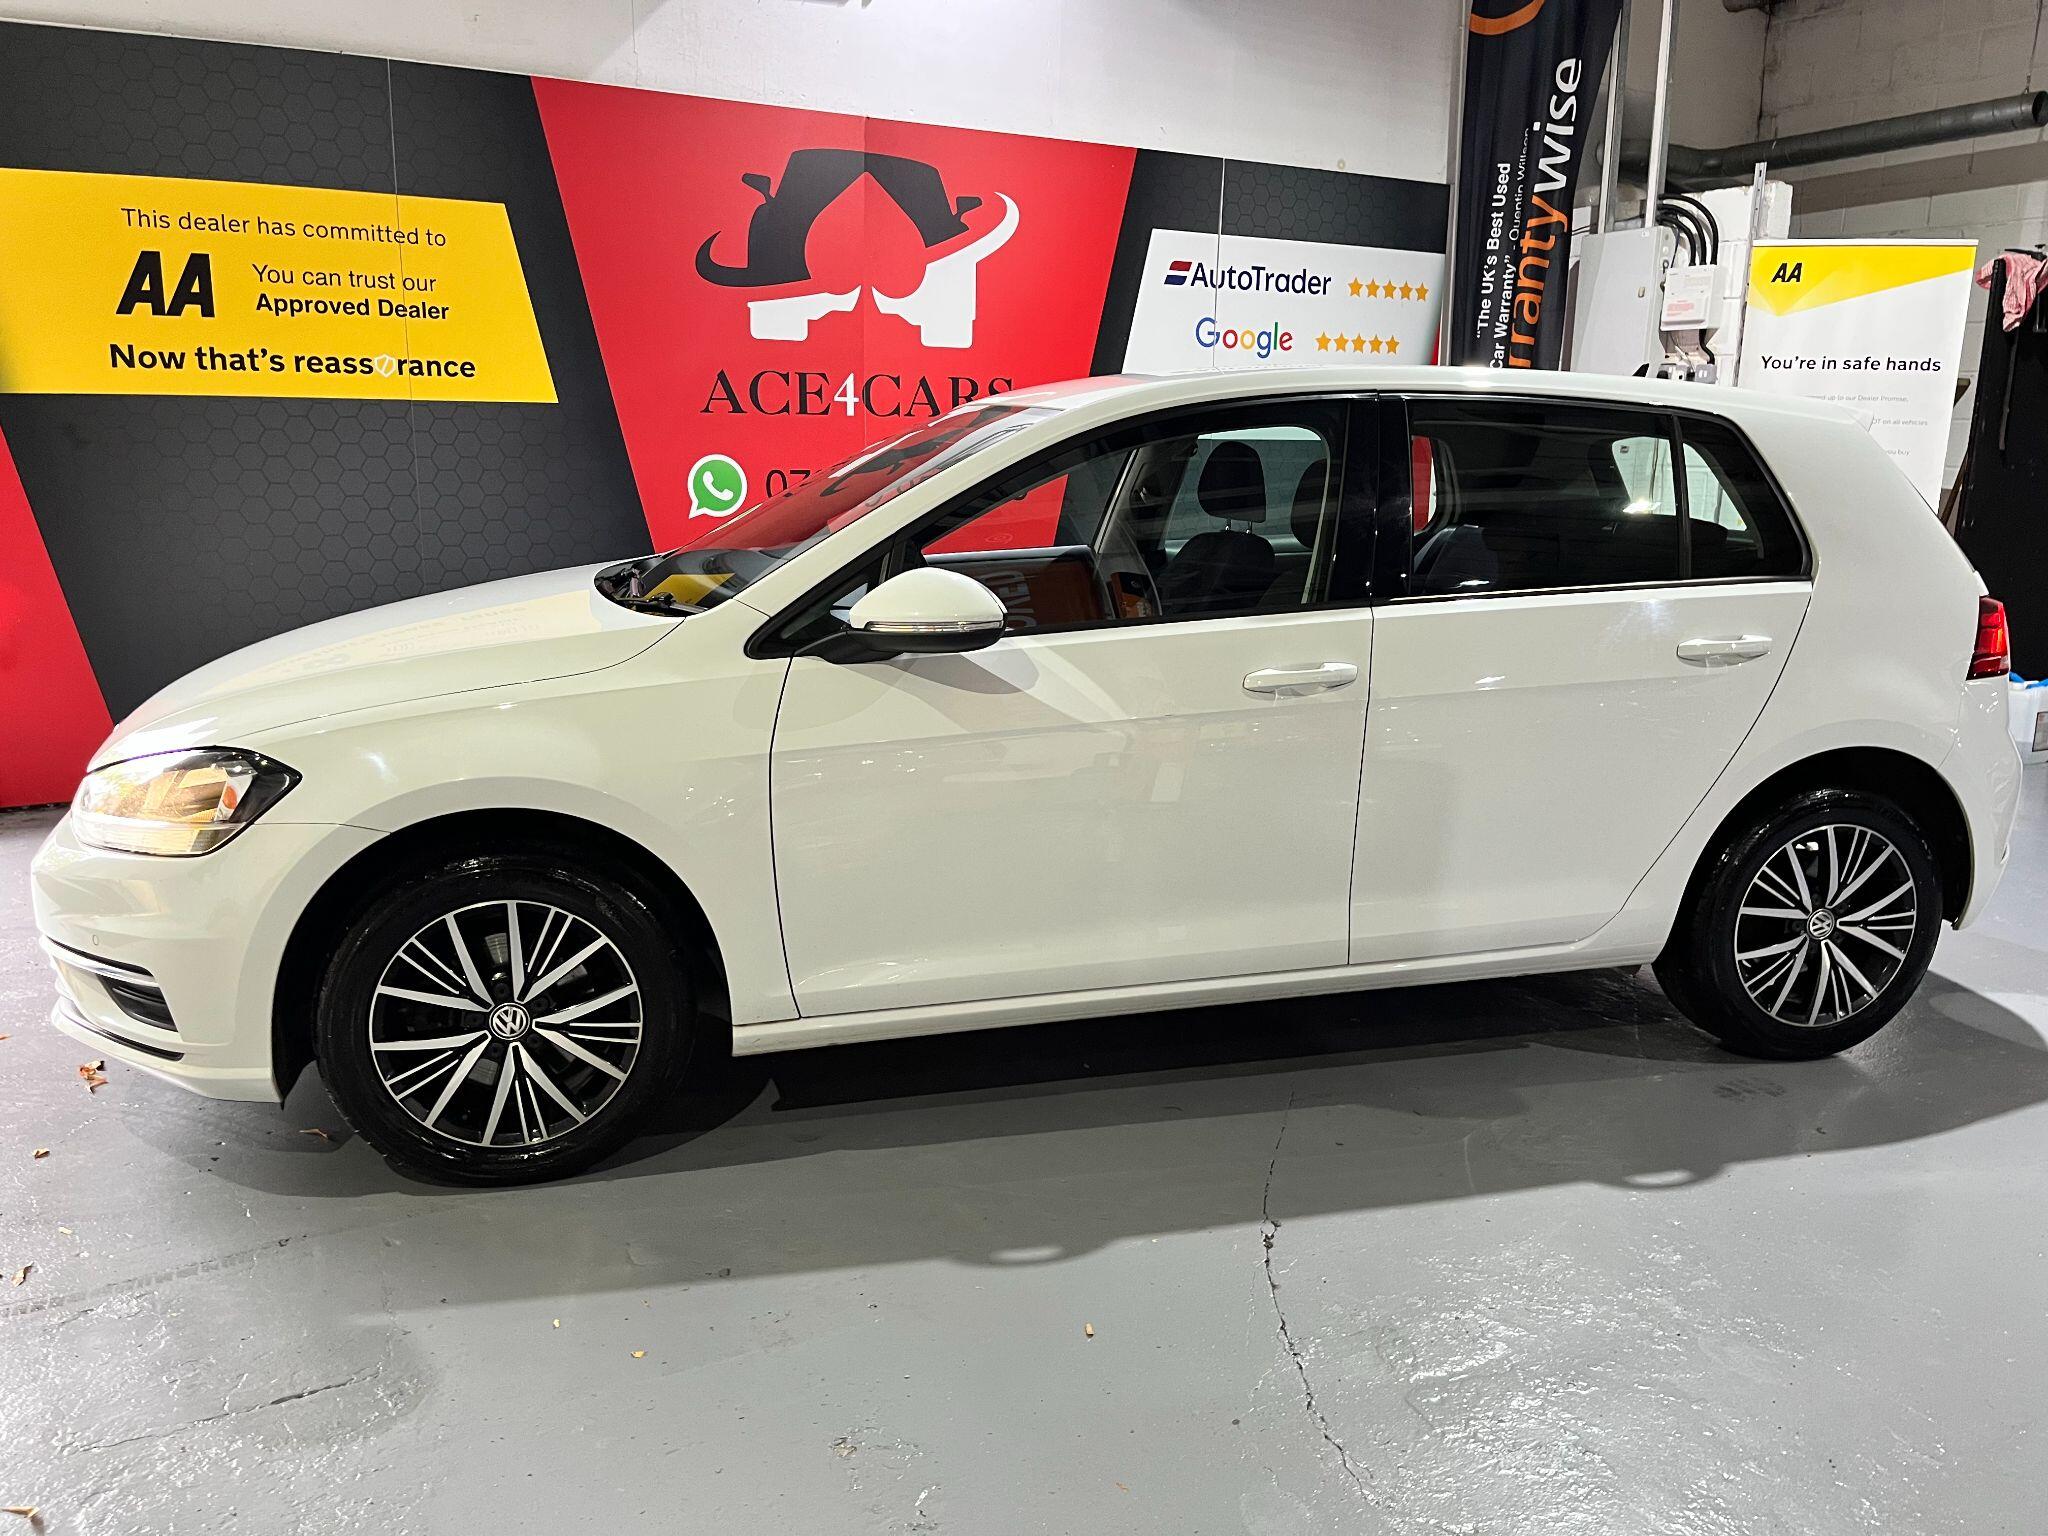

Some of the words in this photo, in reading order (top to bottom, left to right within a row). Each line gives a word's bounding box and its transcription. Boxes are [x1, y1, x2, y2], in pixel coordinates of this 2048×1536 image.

[1492, 163, 1511, 207] Used
[121, 208, 170, 229] This
[179, 211, 249, 234] dealer
[257, 217, 296, 237] has
[303, 222, 419, 246] committed
[425, 228, 446, 247] to
[1487, 211, 1504, 250] Best
[1509, 185, 1524, 240] Quentin
[116, 250, 215, 318] AA
[252, 263, 294, 284] You
[302, 270, 341, 287] can
[349, 270, 395, 290] trust
[403, 275, 437, 292] our
[1191, 262, 1332, 295] AutoTrader
[1481, 255, 1498, 294] UK's
[1771, 262, 1802, 283] AA
[256, 293, 370, 317] Approved
[378, 298, 450, 320] Dealer
[1494, 255, 1516, 338] Warranty"
[1195, 316, 1293, 359] Google
[1489, 343, 1505, 368] Car
[110, 343, 185, 370] Now
[195, 346, 285, 373] that's
[1761, 356, 1816, 370] You're
[1821, 356, 1837, 370] in
[1842, 356, 1881, 371] safe
[1886, 357, 1941, 371] hands
[1897, 449, 1911, 457] buy
